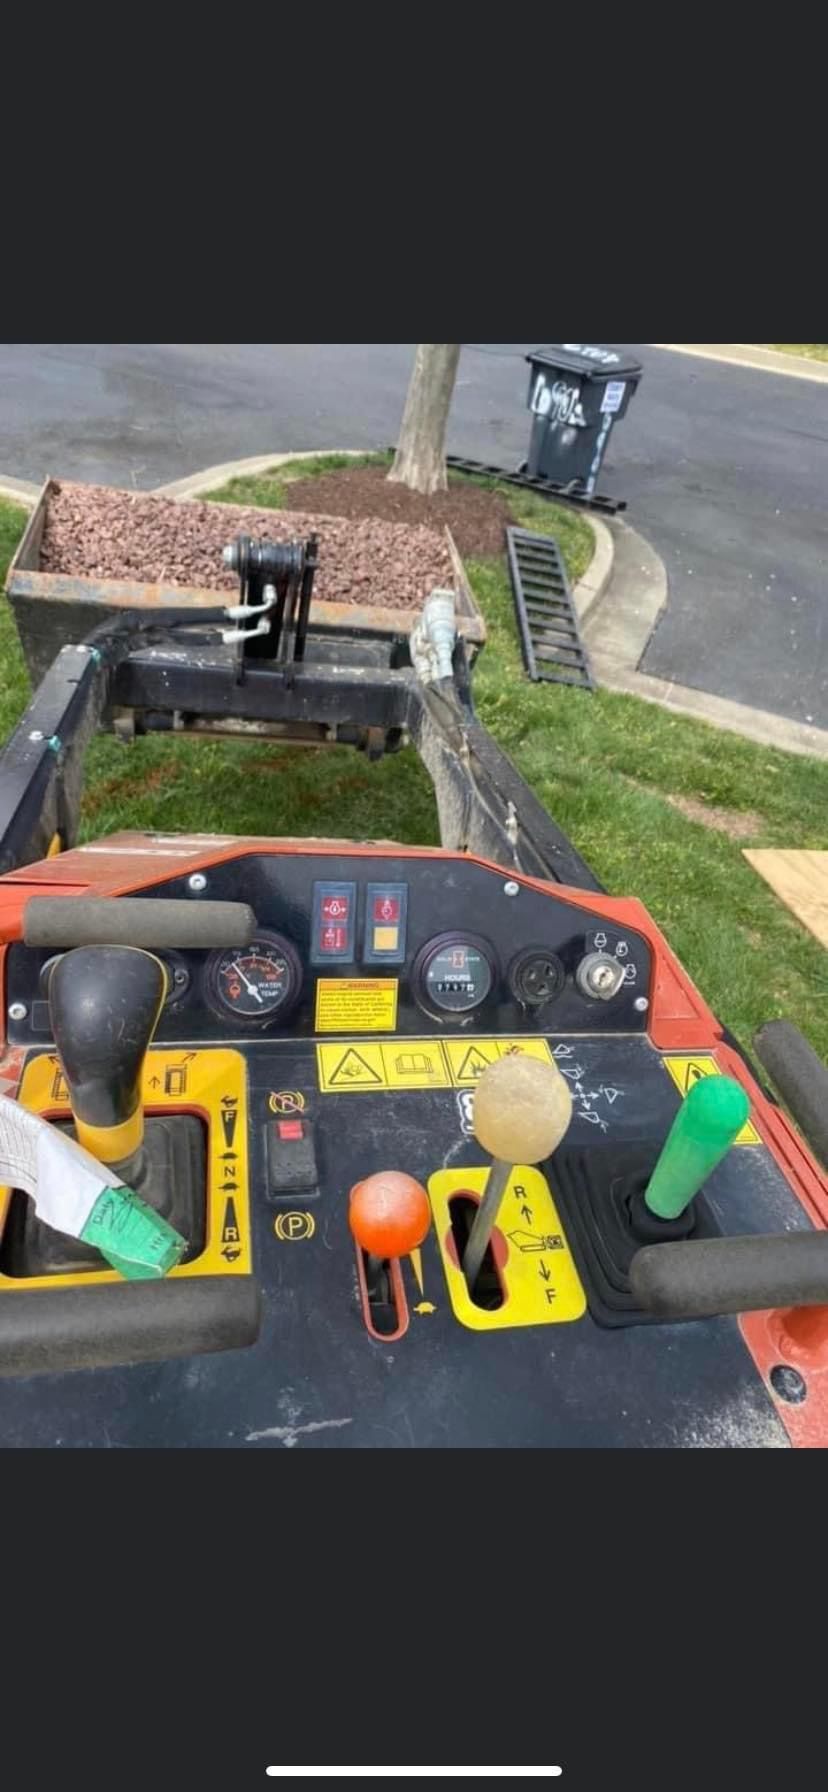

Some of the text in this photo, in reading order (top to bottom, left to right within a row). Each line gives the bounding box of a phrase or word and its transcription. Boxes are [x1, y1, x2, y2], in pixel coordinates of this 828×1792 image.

[445, 974, 471, 982] HOURS
[225, 1111, 235, 1122] F
[224, 1166, 236, 1177] N
[513, 1185, 527, 1199] R
[225, 1227, 238, 1241] R
[288, 1217, 303, 1237] P
[546, 1288, 556, 1305] F
